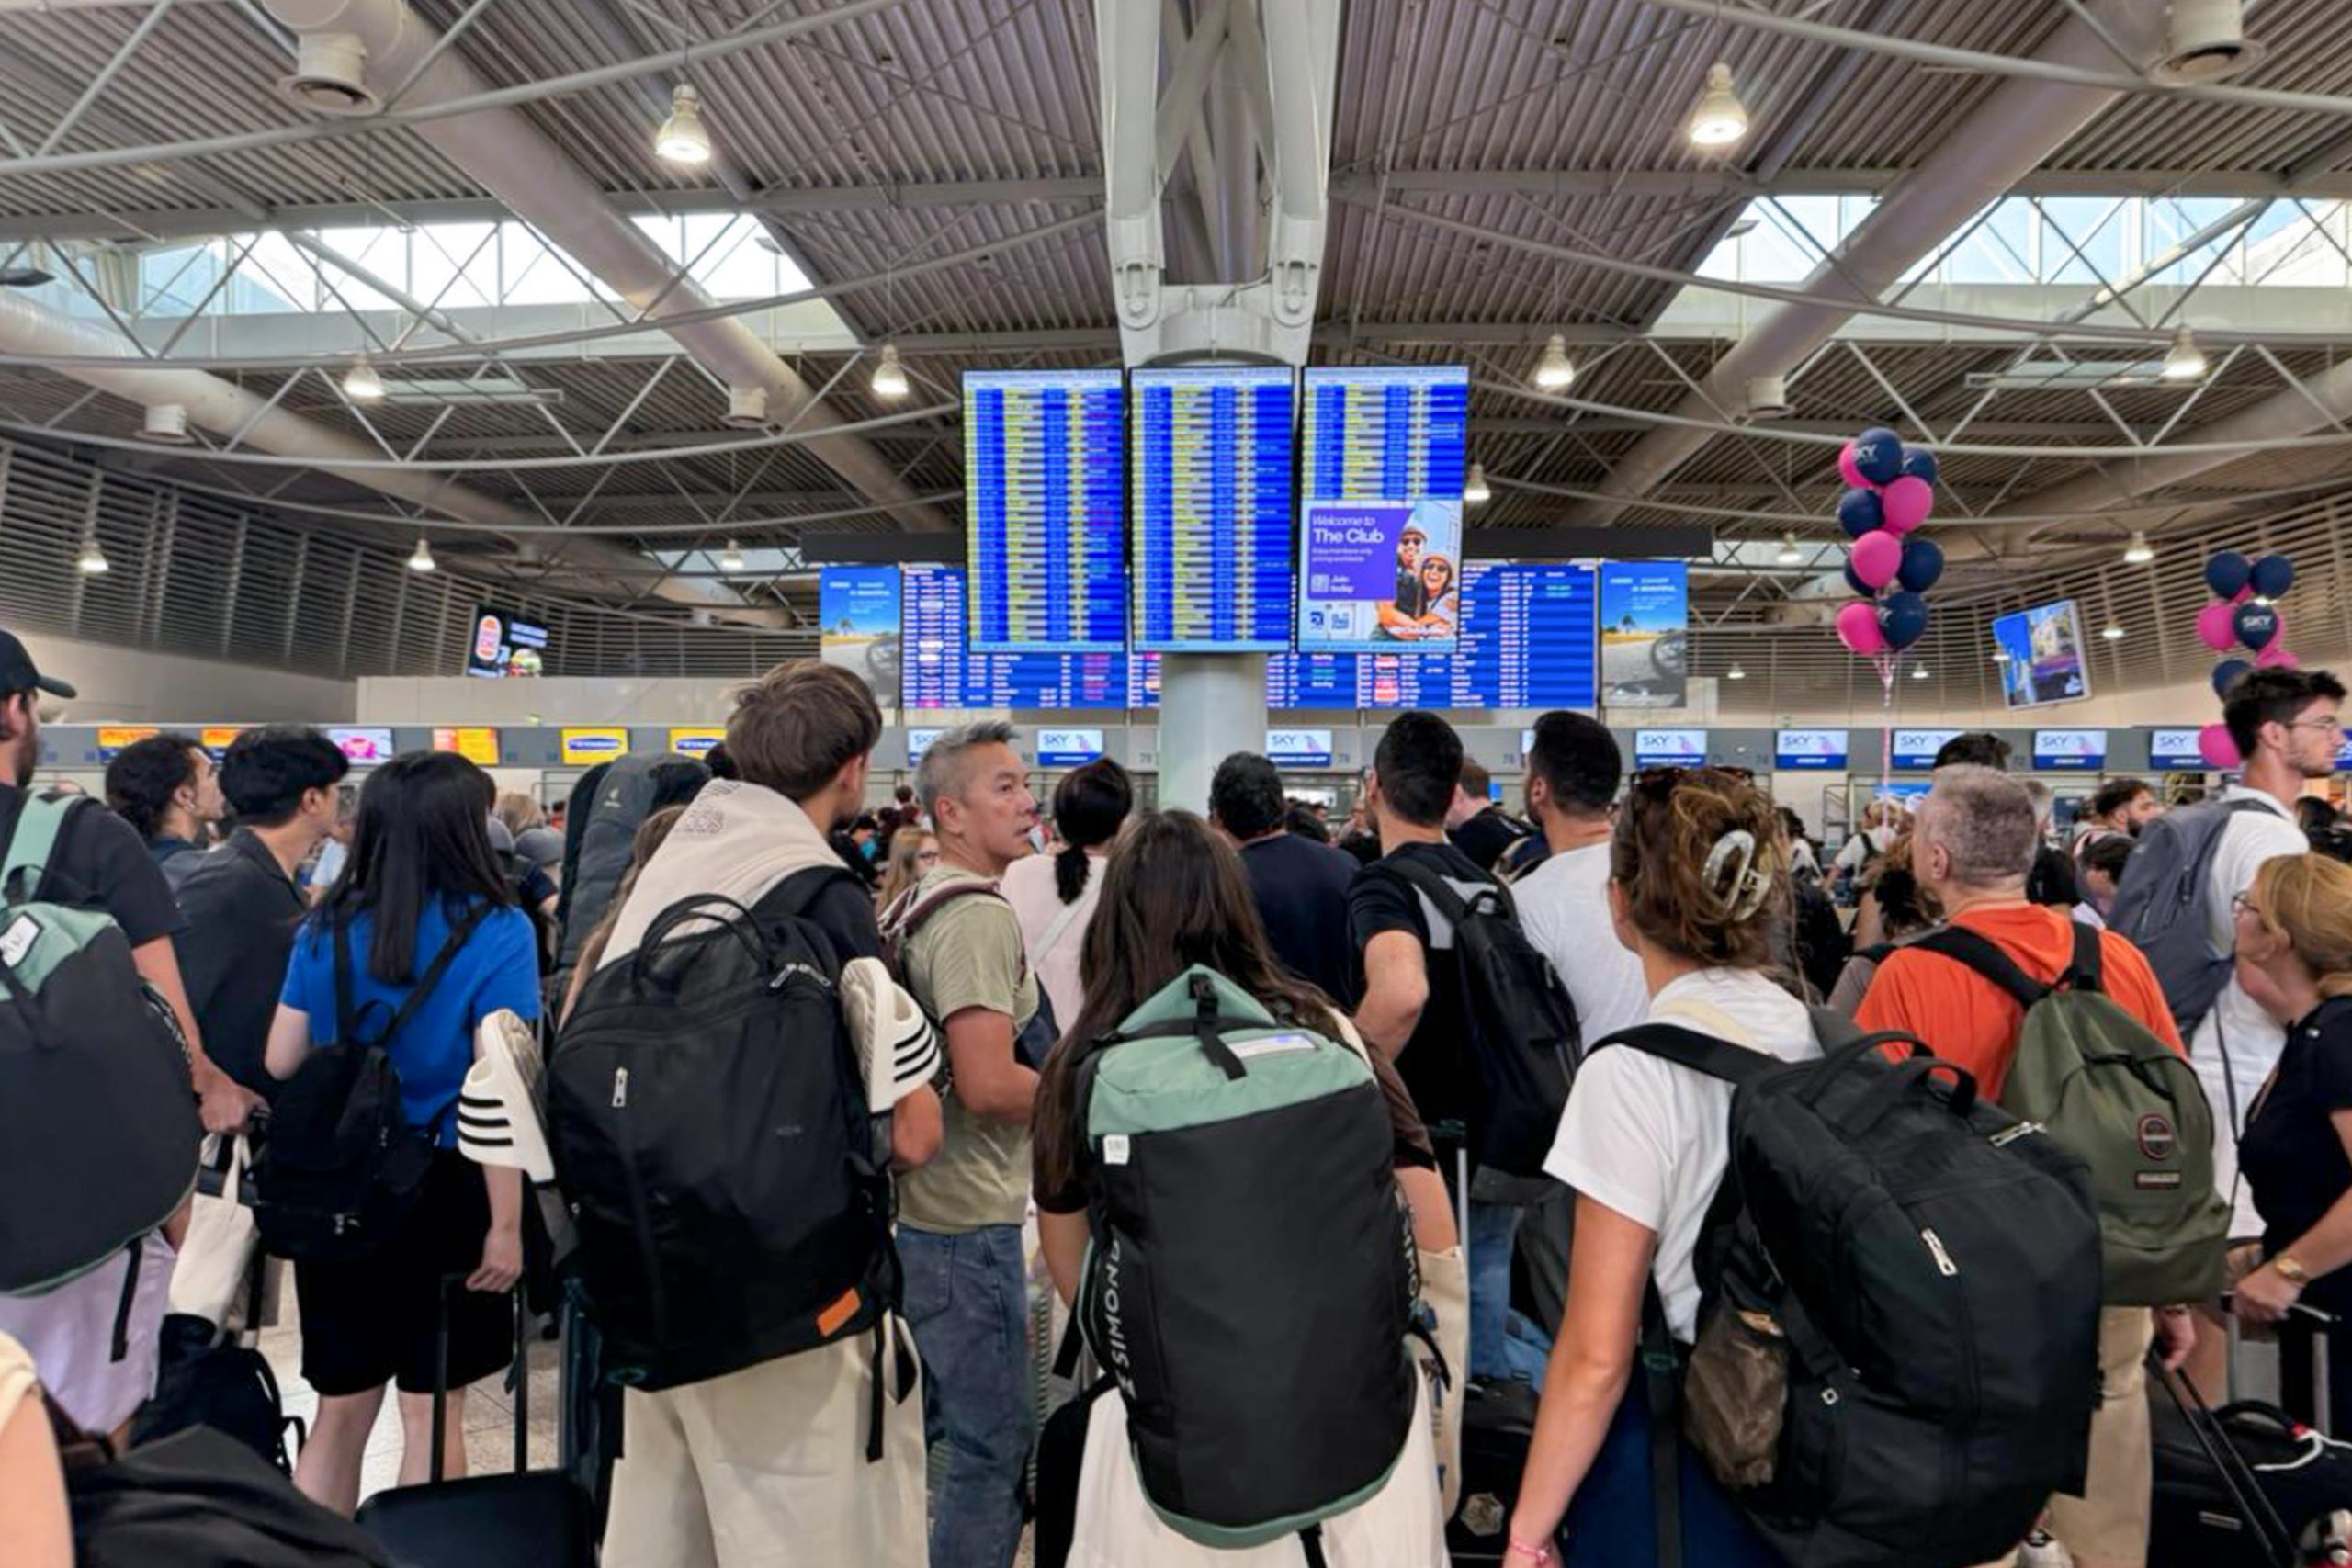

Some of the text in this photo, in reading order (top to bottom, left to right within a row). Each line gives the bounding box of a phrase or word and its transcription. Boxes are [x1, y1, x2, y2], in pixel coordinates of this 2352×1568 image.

[1312, 514, 1376, 526] Welcome to
[1313, 527, 1385, 544] The Club
[1330, 584, 1355, 594] today
[2243, 615, 2271, 628] SKY
[1044, 734, 1069, 745] SKY
[1272, 734, 1296, 745] SKY
[1643, 735, 1669, 746] SKY
[1784, 735, 1810, 746] SKY
[1901, 735, 1928, 746] SKY
[2041, 736, 2067, 747] SKY
[2160, 736, 2187, 747] SKY
[1104, 1238, 1130, 1368] SIMOND
